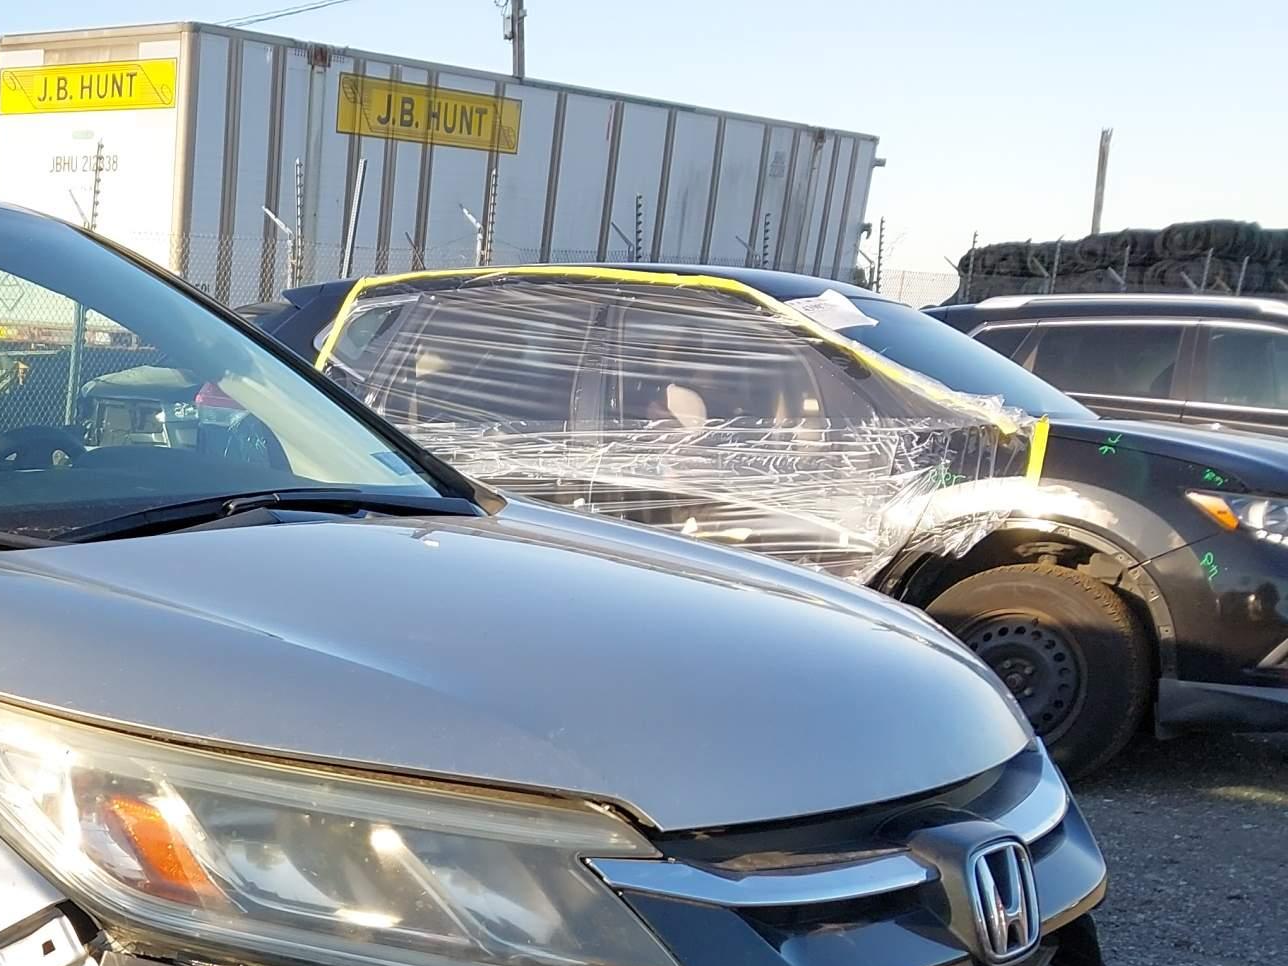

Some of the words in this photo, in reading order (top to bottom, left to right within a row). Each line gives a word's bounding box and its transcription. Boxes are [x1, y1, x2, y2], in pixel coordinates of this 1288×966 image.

[37, 76, 73, 102] J.B.
[79, 72, 138, 100] HUNT
[376, 94, 420, 130] J.B.
[426, 100, 489, 137] HUNT
[49, 155, 78, 174] JBHU
